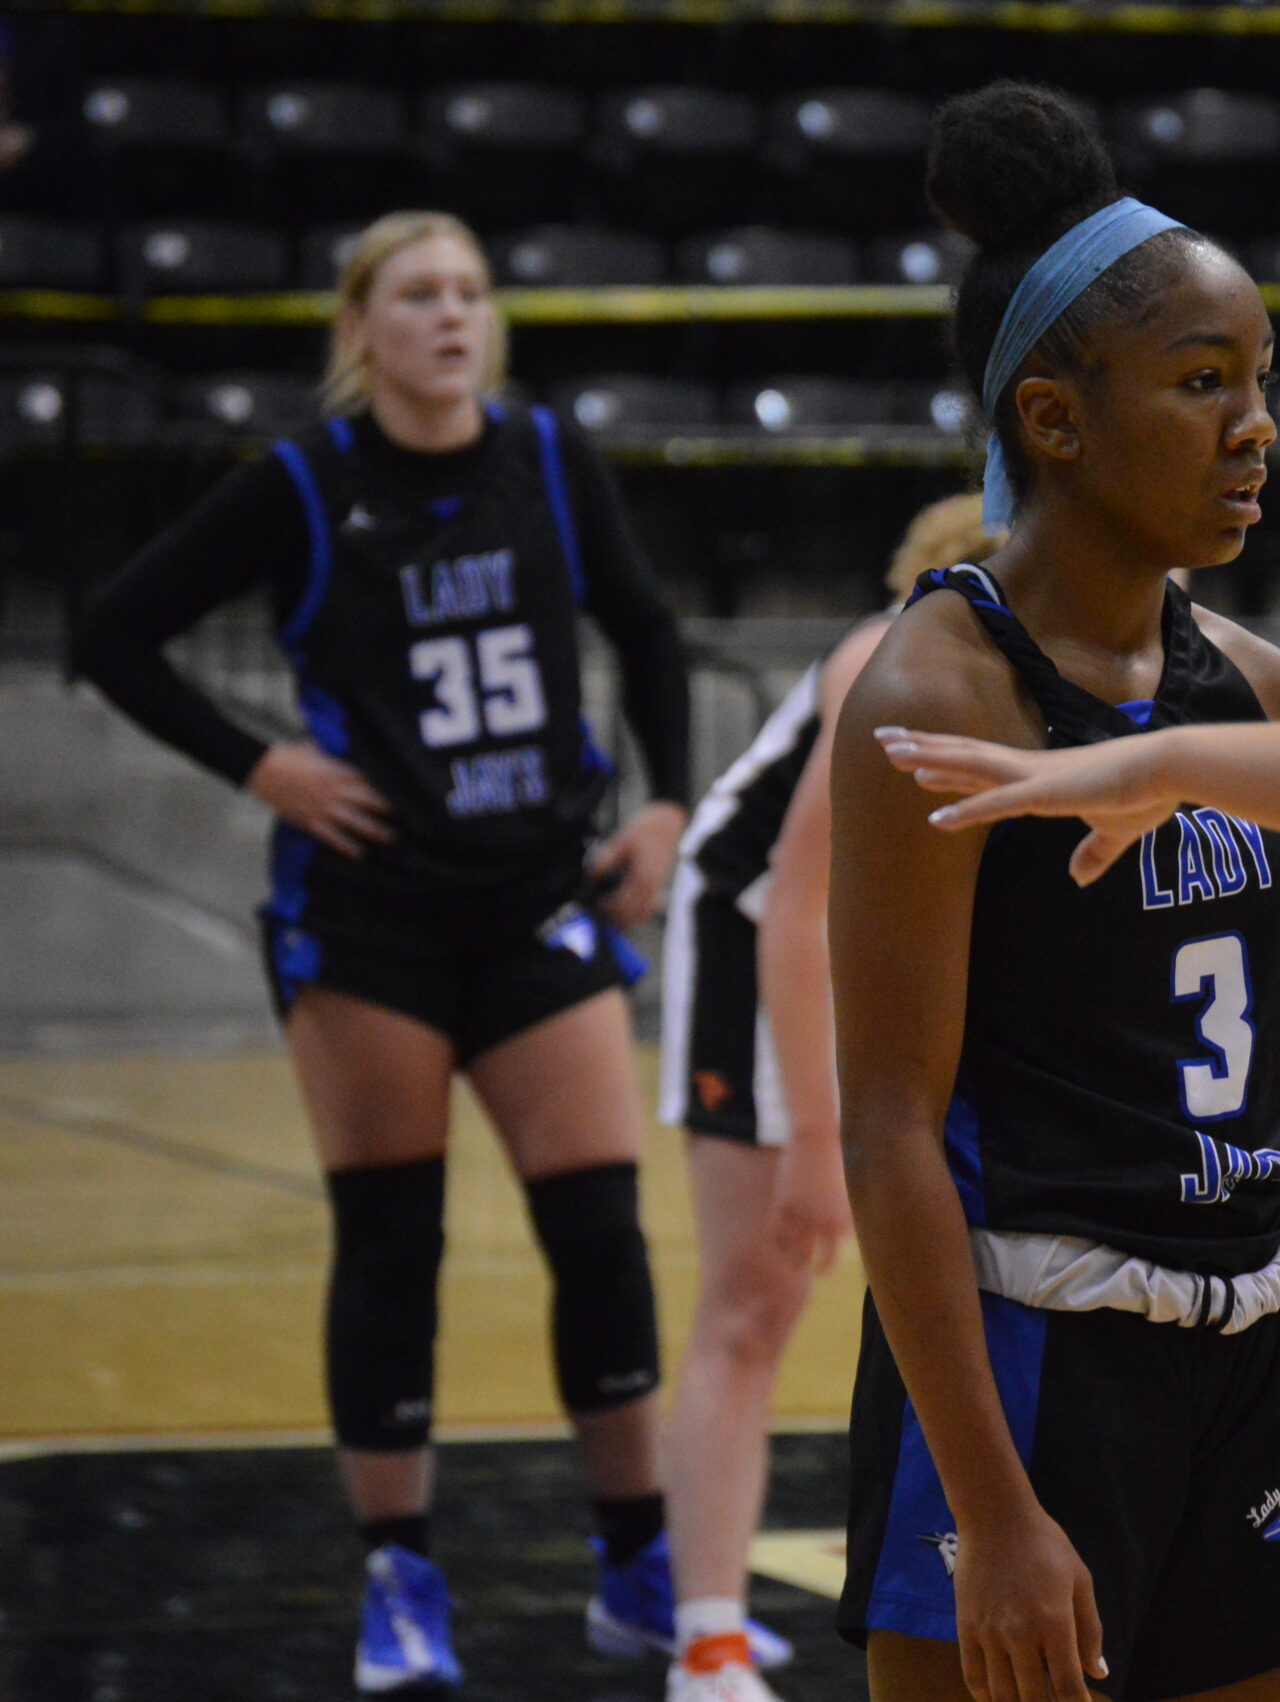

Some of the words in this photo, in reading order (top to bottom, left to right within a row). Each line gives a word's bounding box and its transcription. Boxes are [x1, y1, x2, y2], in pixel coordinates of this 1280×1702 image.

[401, 548, 515, 628] LADY
[409, 622, 549, 749] 35
[1139, 806, 1272, 911] LADY
[1169, 929, 1256, 1124] 3
